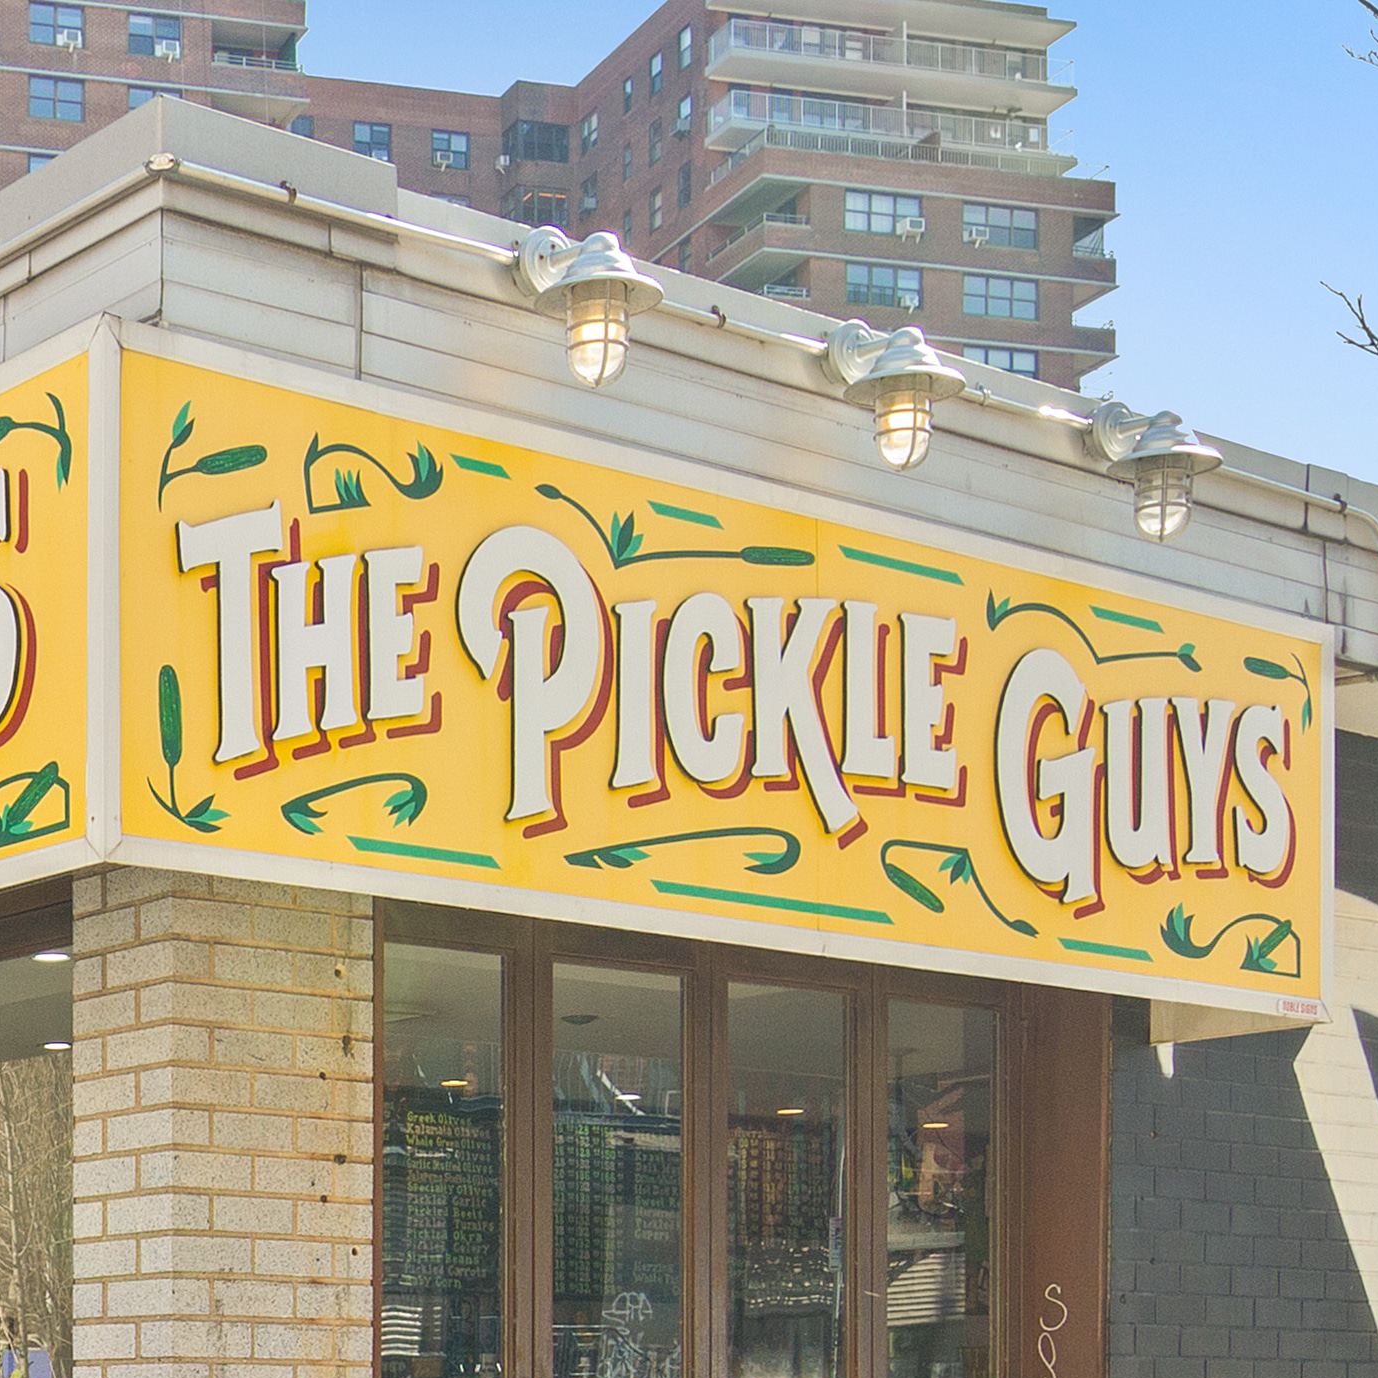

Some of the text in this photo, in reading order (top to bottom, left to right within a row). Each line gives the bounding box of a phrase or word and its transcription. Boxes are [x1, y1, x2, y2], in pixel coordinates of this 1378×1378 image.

[177, 499, 1296, 919] THE PICKLE GUYS
[453, 1230, 483, 1242] Okra
